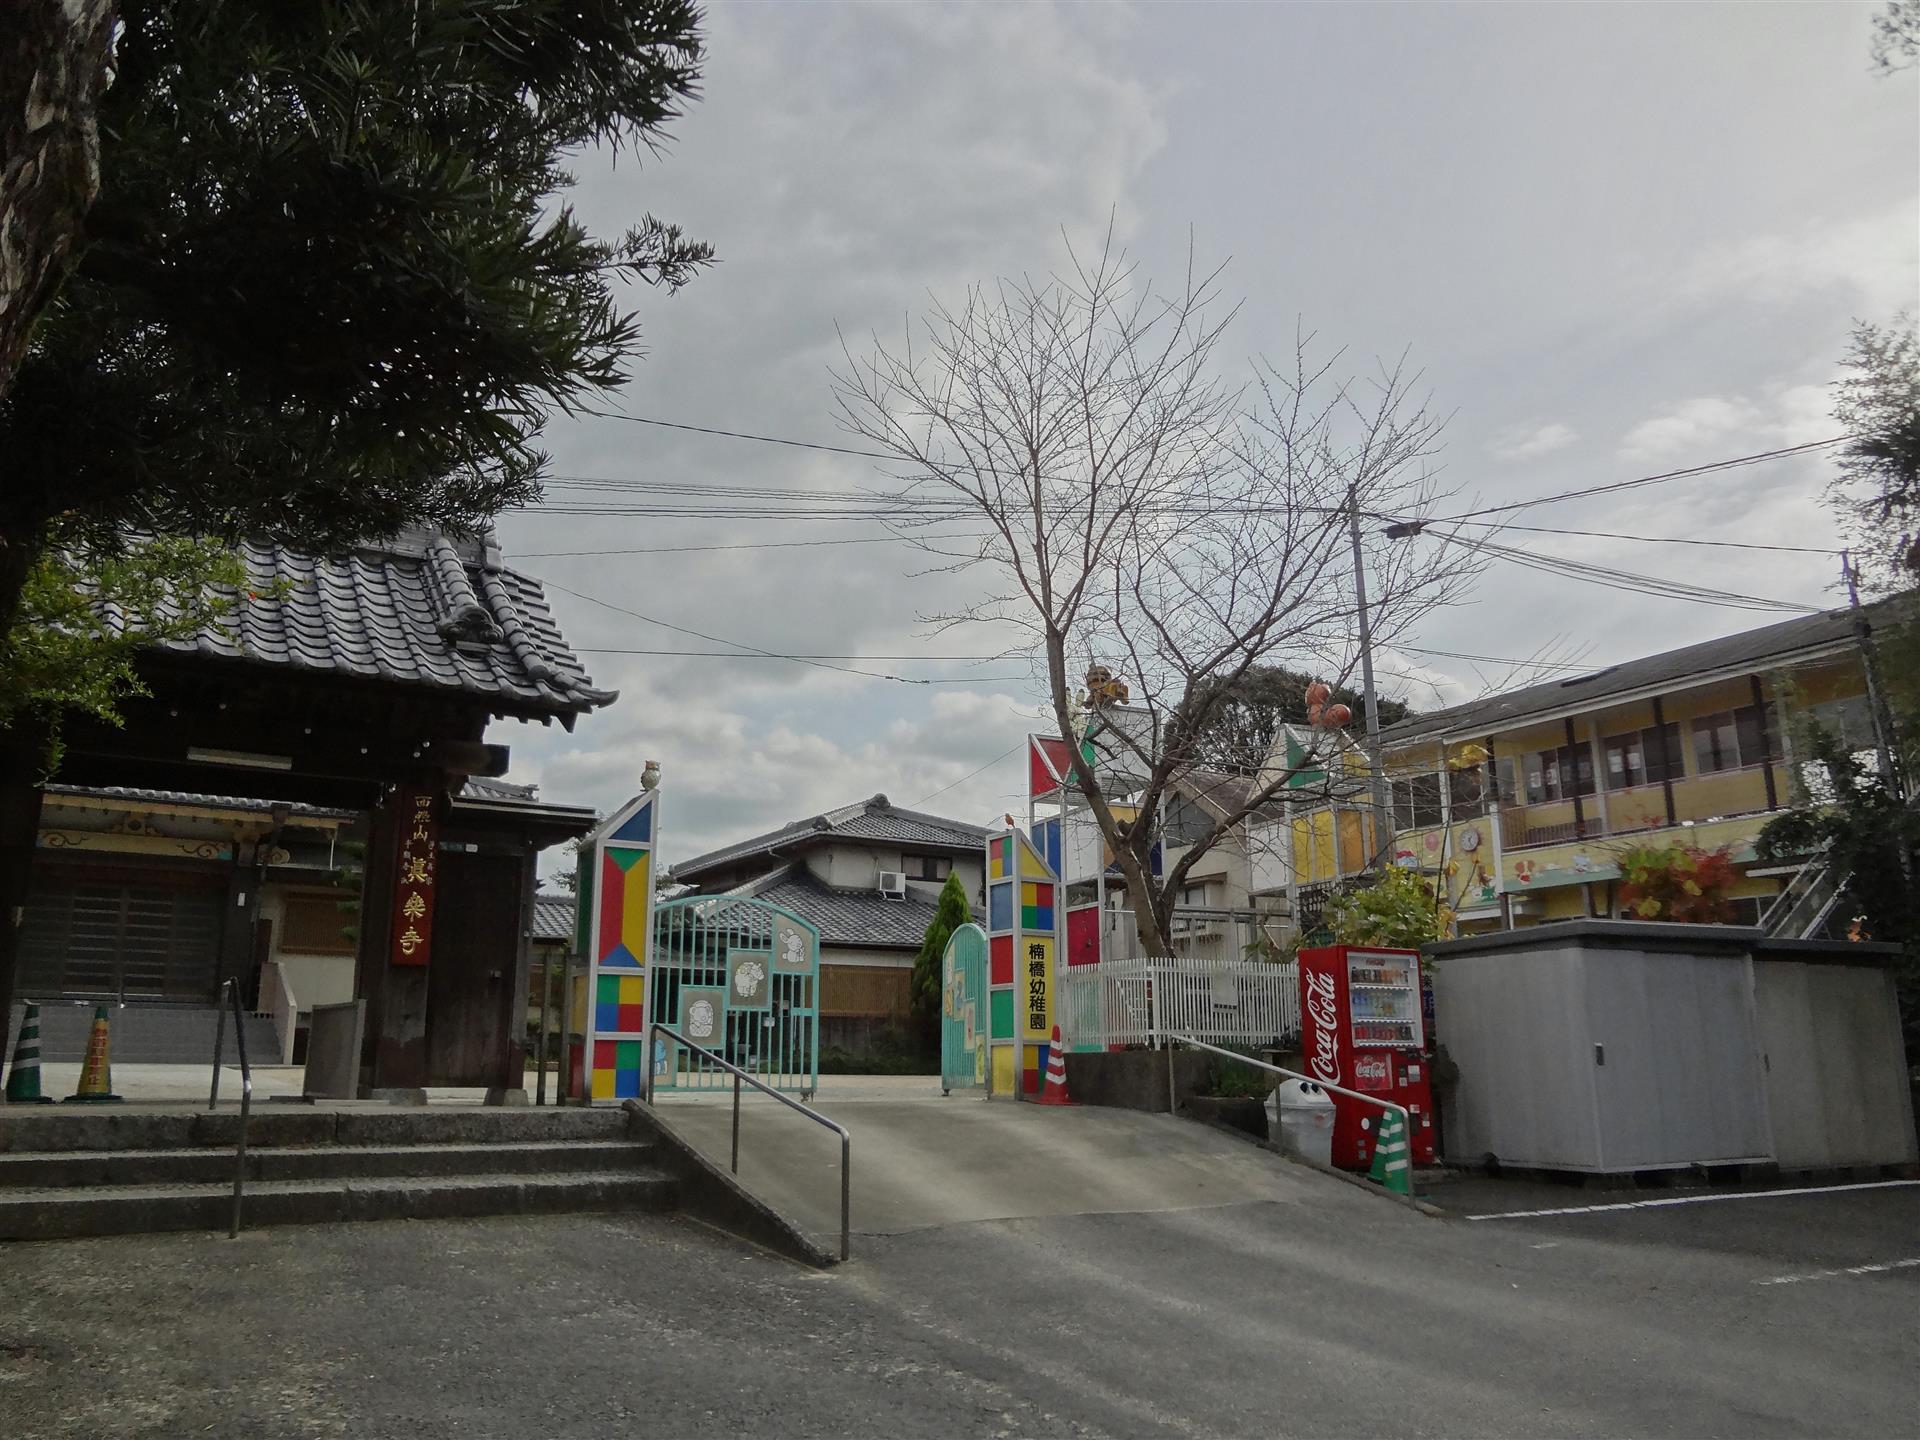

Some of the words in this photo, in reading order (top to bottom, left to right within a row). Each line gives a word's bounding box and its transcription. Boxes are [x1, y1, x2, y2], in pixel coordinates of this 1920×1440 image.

[1029, 943, 1046, 1030] 楠橋幼稚園
[1306, 967, 1341, 1086] Coca-Cola
